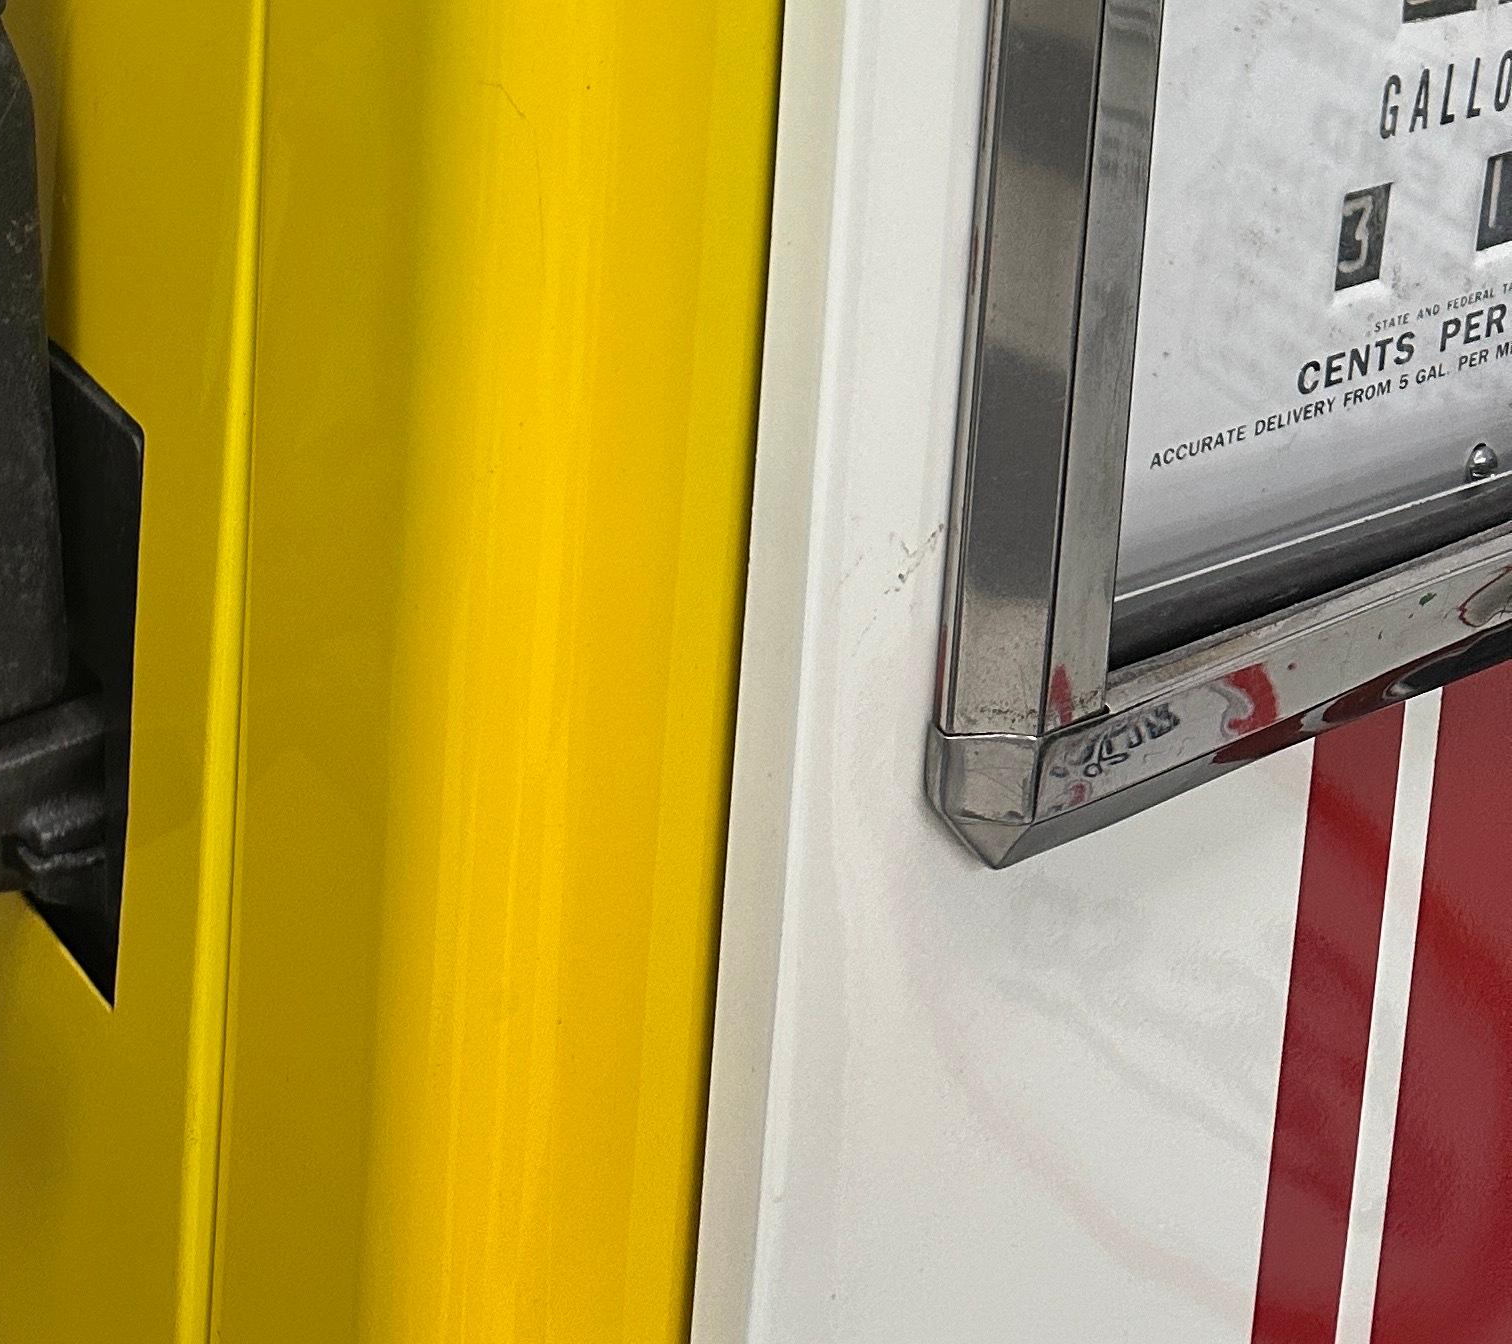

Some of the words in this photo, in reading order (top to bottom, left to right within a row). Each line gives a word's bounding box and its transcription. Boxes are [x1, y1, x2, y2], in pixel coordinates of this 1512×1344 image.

[1378, 48, 1512, 140] GALLO
[1337, 194, 1374, 274] 3
[1296, 330, 1416, 396] CENTS
[1439, 303, 1508, 353] PER
[1373, 312, 1410, 334] STATE
[1416, 303, 1441, 321] AND
[1446, 288, 1495, 312] FEDERAL
[1148, 424, 1247, 470] ACCURATE
[1253, 396, 1337, 437] DELIVERY
[1342, 378, 1392, 408] FROM
[1398, 373, 1409, 390] 5
[1457, 348, 1490, 373] PER
